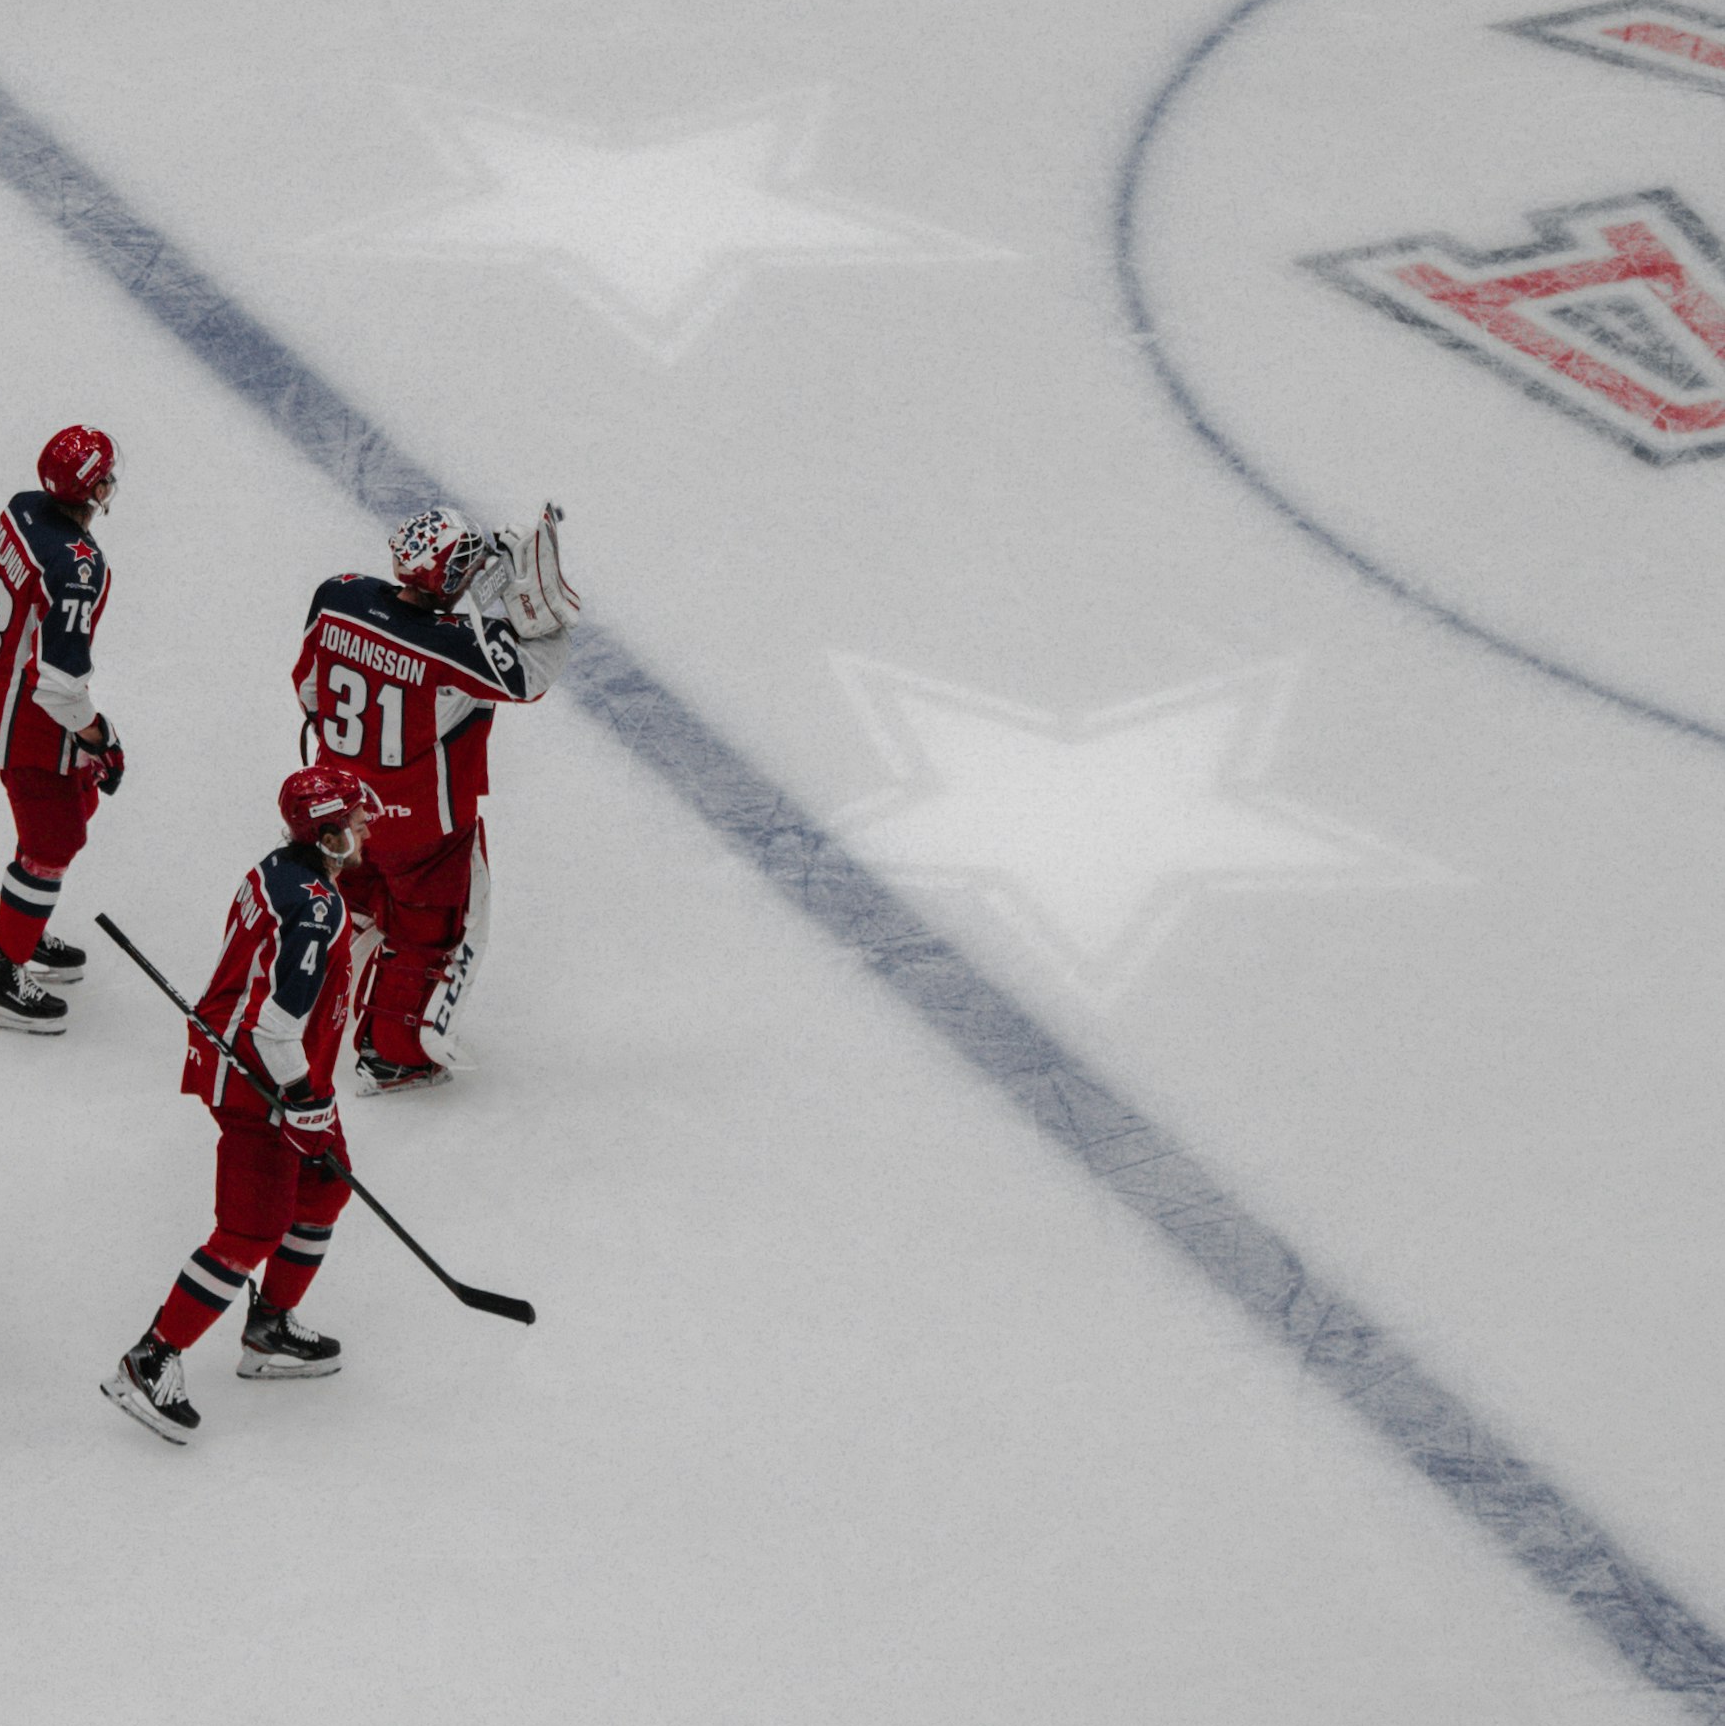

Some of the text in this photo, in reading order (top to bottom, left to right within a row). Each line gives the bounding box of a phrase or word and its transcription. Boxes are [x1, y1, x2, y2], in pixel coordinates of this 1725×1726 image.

[62, 598, 92, 635] 78
[319, 622, 427, 687] JOHANSSON
[489, 629, 522, 673] 31
[324, 663, 405, 768] 31
[300, 940, 319, 976] 4
[434, 941, 475, 1038] CCM
